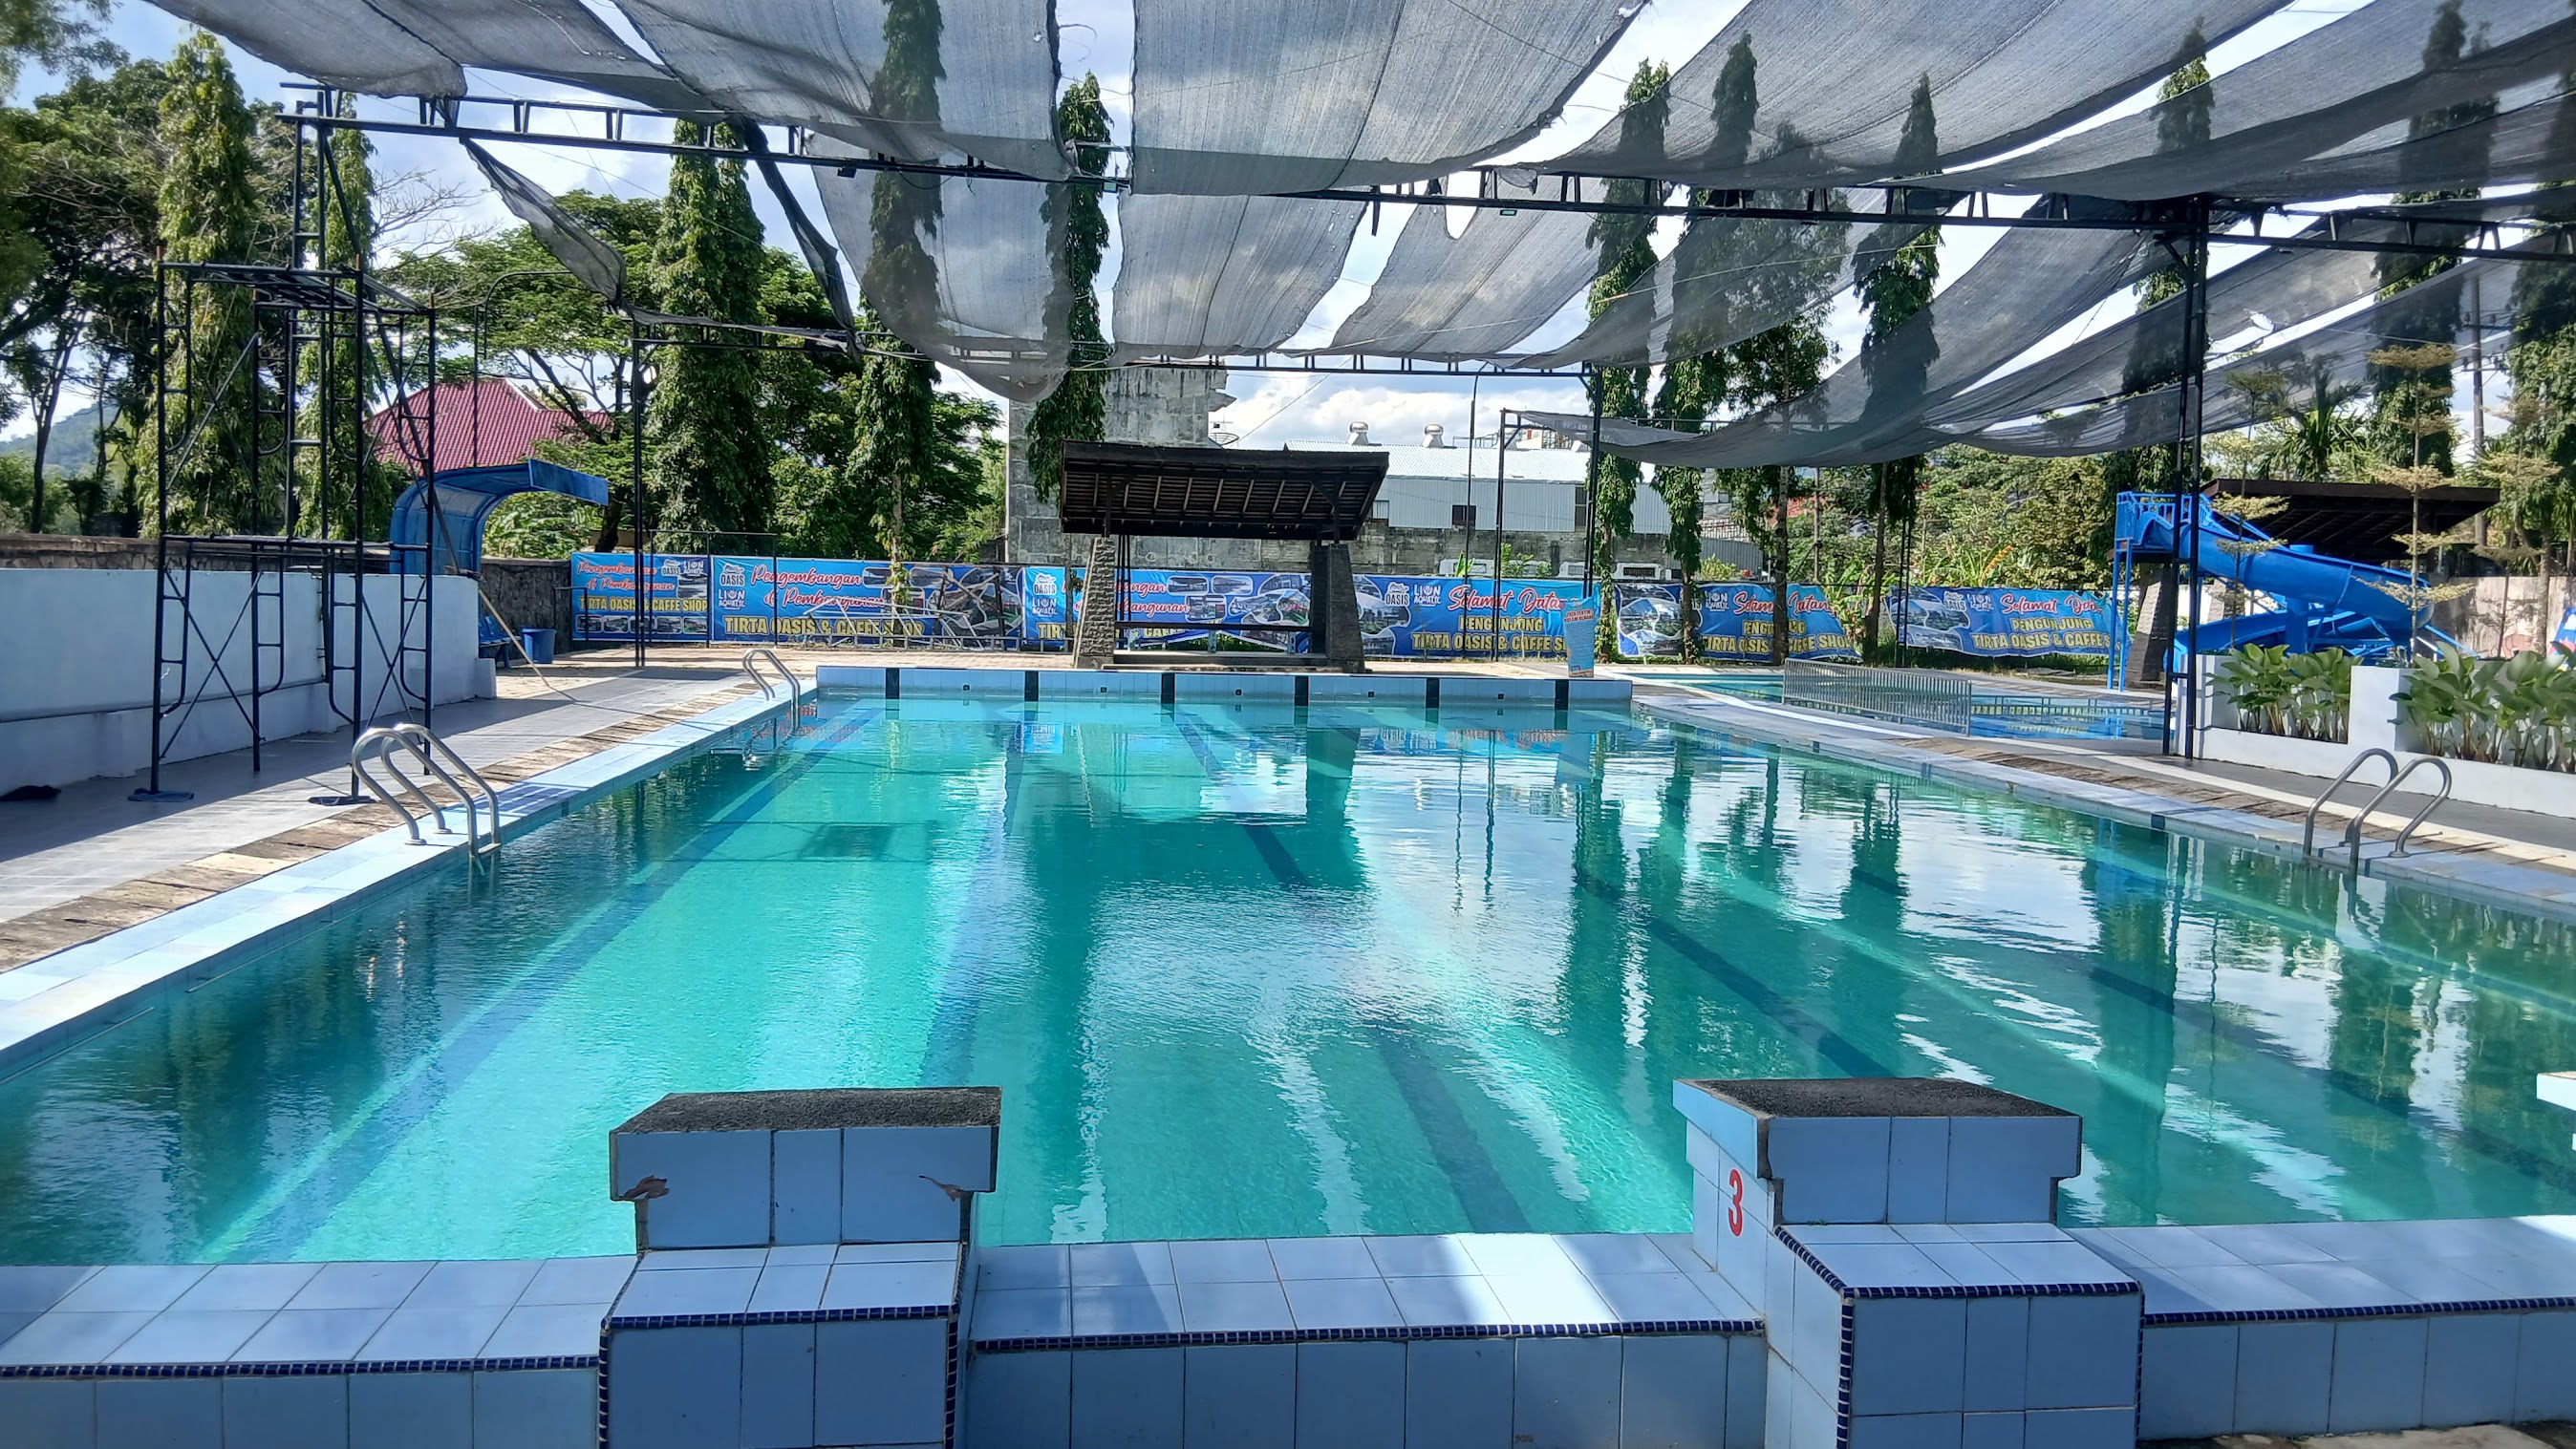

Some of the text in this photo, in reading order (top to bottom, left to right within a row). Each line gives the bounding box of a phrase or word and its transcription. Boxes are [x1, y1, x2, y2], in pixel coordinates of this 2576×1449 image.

[720, 574, 744, 586] OASIS
[1034, 584, 1057, 594] OASIS
[579, 596, 608, 611] TRTA
[652, 599, 680, 612] CAFFE
[682, 599, 708, 613] SHOP
[1385, 594, 1408, 606] OASIS
[723, 617, 769, 634] TIRTA
[771, 617, 817, 635] OASIS
[2010, 617, 2093, 631] PENGUNJUNG
[1497, 634, 1509, 650] &
[1511, 635, 1551, 650] CAFFE
[1970, 633, 2009, 649] TIRTA
[2011, 631, 2050, 649] OASIS
[2052, 633, 2063, 647] &
[2064, 631, 2103, 647] CAFFE
[1728, 1168, 1743, 1237] 3
